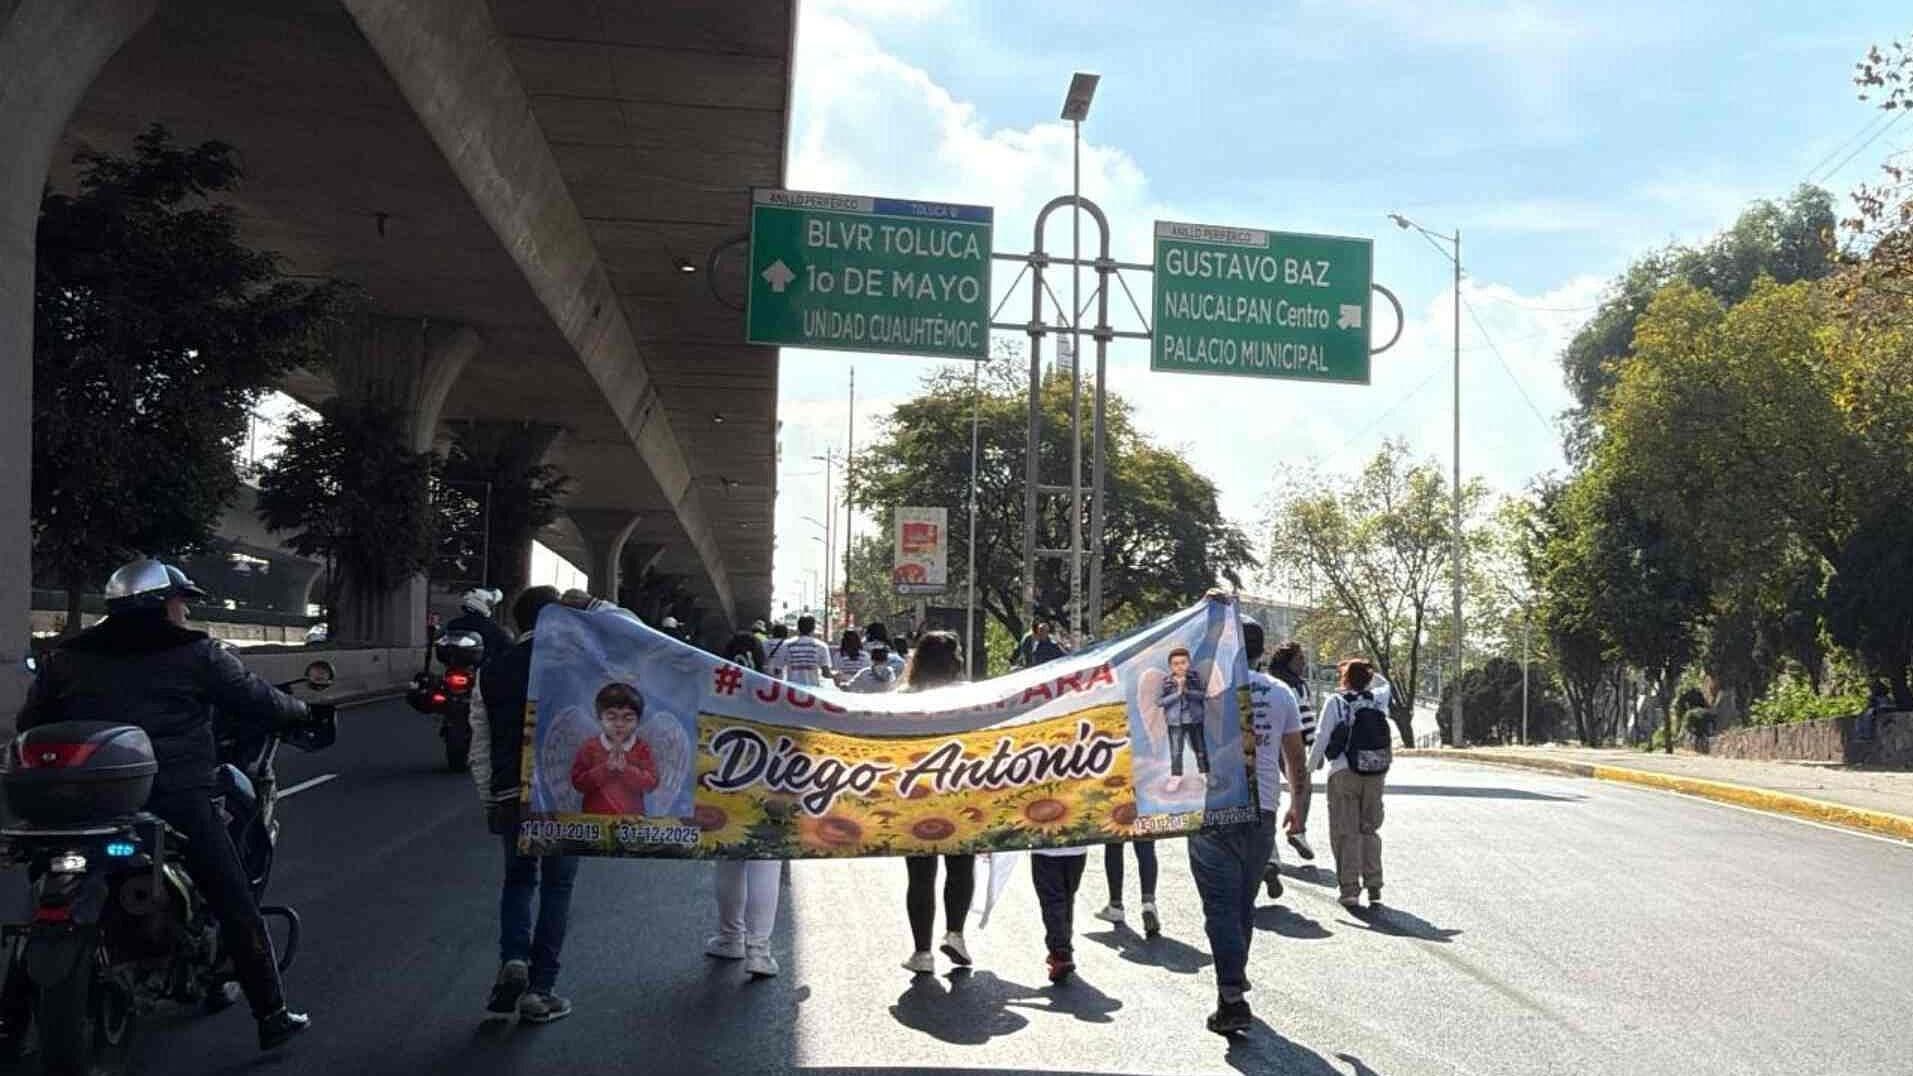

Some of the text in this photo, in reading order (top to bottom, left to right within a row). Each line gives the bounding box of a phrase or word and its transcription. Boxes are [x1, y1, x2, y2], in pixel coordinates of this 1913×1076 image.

[808, 219, 981, 260] BLVR TOLUCA
[843, 267, 883, 297] DE
[892, 270, 980, 303] MAYO
[1166, 248, 1330, 287] GUSTAVO BAZ
[803, 307, 979, 348] UNIDAD CUAUHTÉMOC
[1165, 290, 1330, 329] NAUCALPAN Centro
[1163, 335, 1329, 372] PALACIO MUNICIPAL
[714, 663, 743, 695] #
[704, 721, 1129, 816] Diego Antonio
